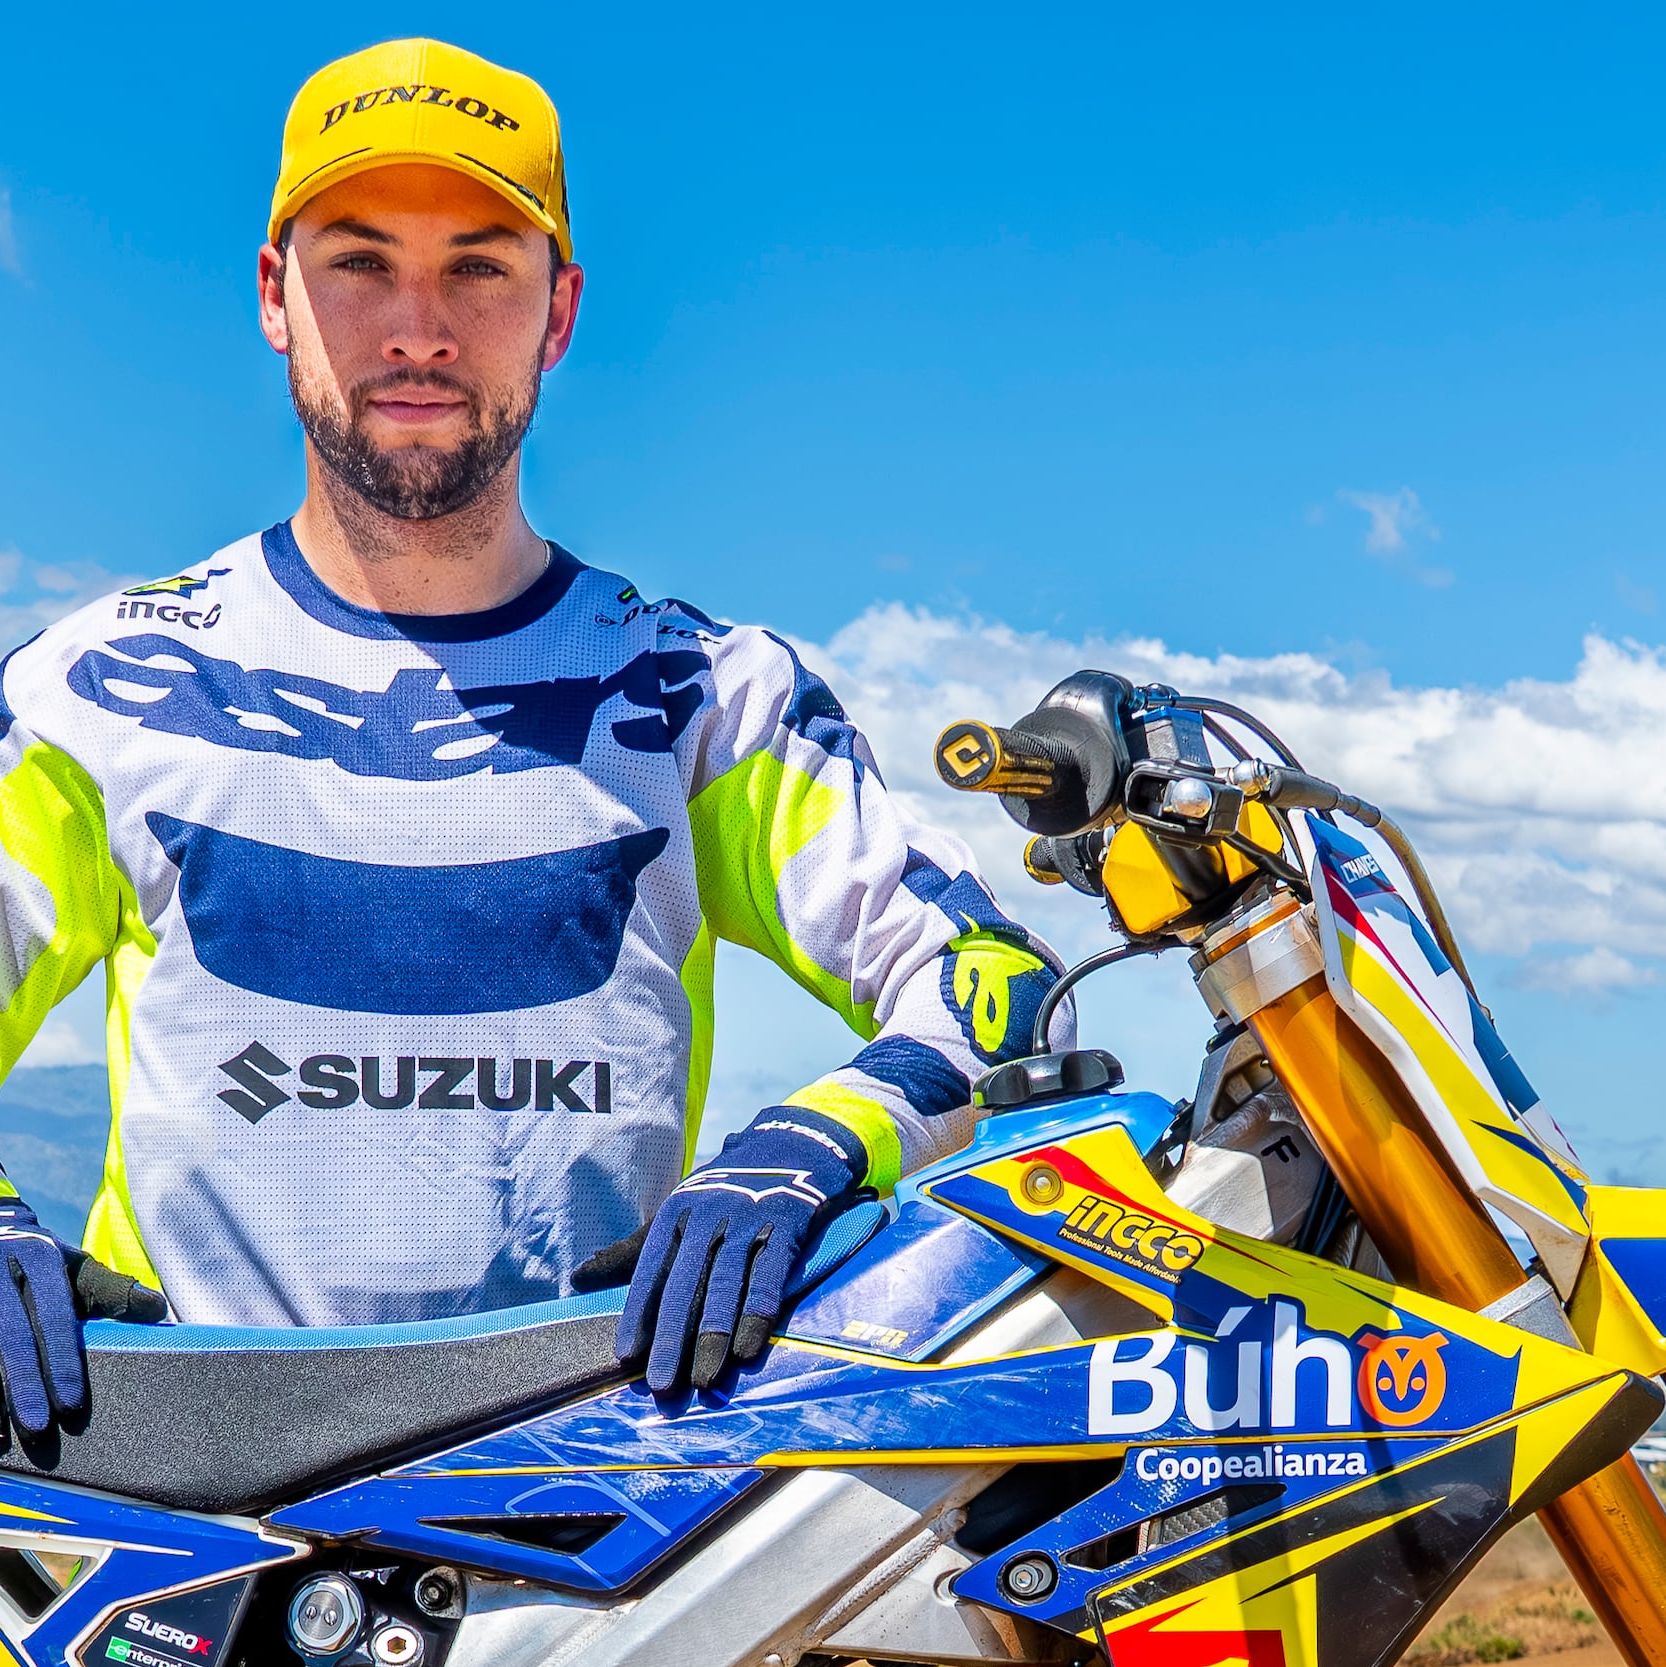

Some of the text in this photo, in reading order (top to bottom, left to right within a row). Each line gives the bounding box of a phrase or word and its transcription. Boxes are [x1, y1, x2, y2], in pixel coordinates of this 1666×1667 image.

[320, 84, 521, 136] DUNLOP
[296, 1055, 611, 1115] SUZUKI
[1058, 1227, 1104, 1252] Professional
[1104, 1246, 1124, 1261] Tools
[1124, 1254, 1144, 1268] Made
[1135, 1445, 1368, 1487] Coopealianza
[124, 1612, 214, 1657] SUEROX
